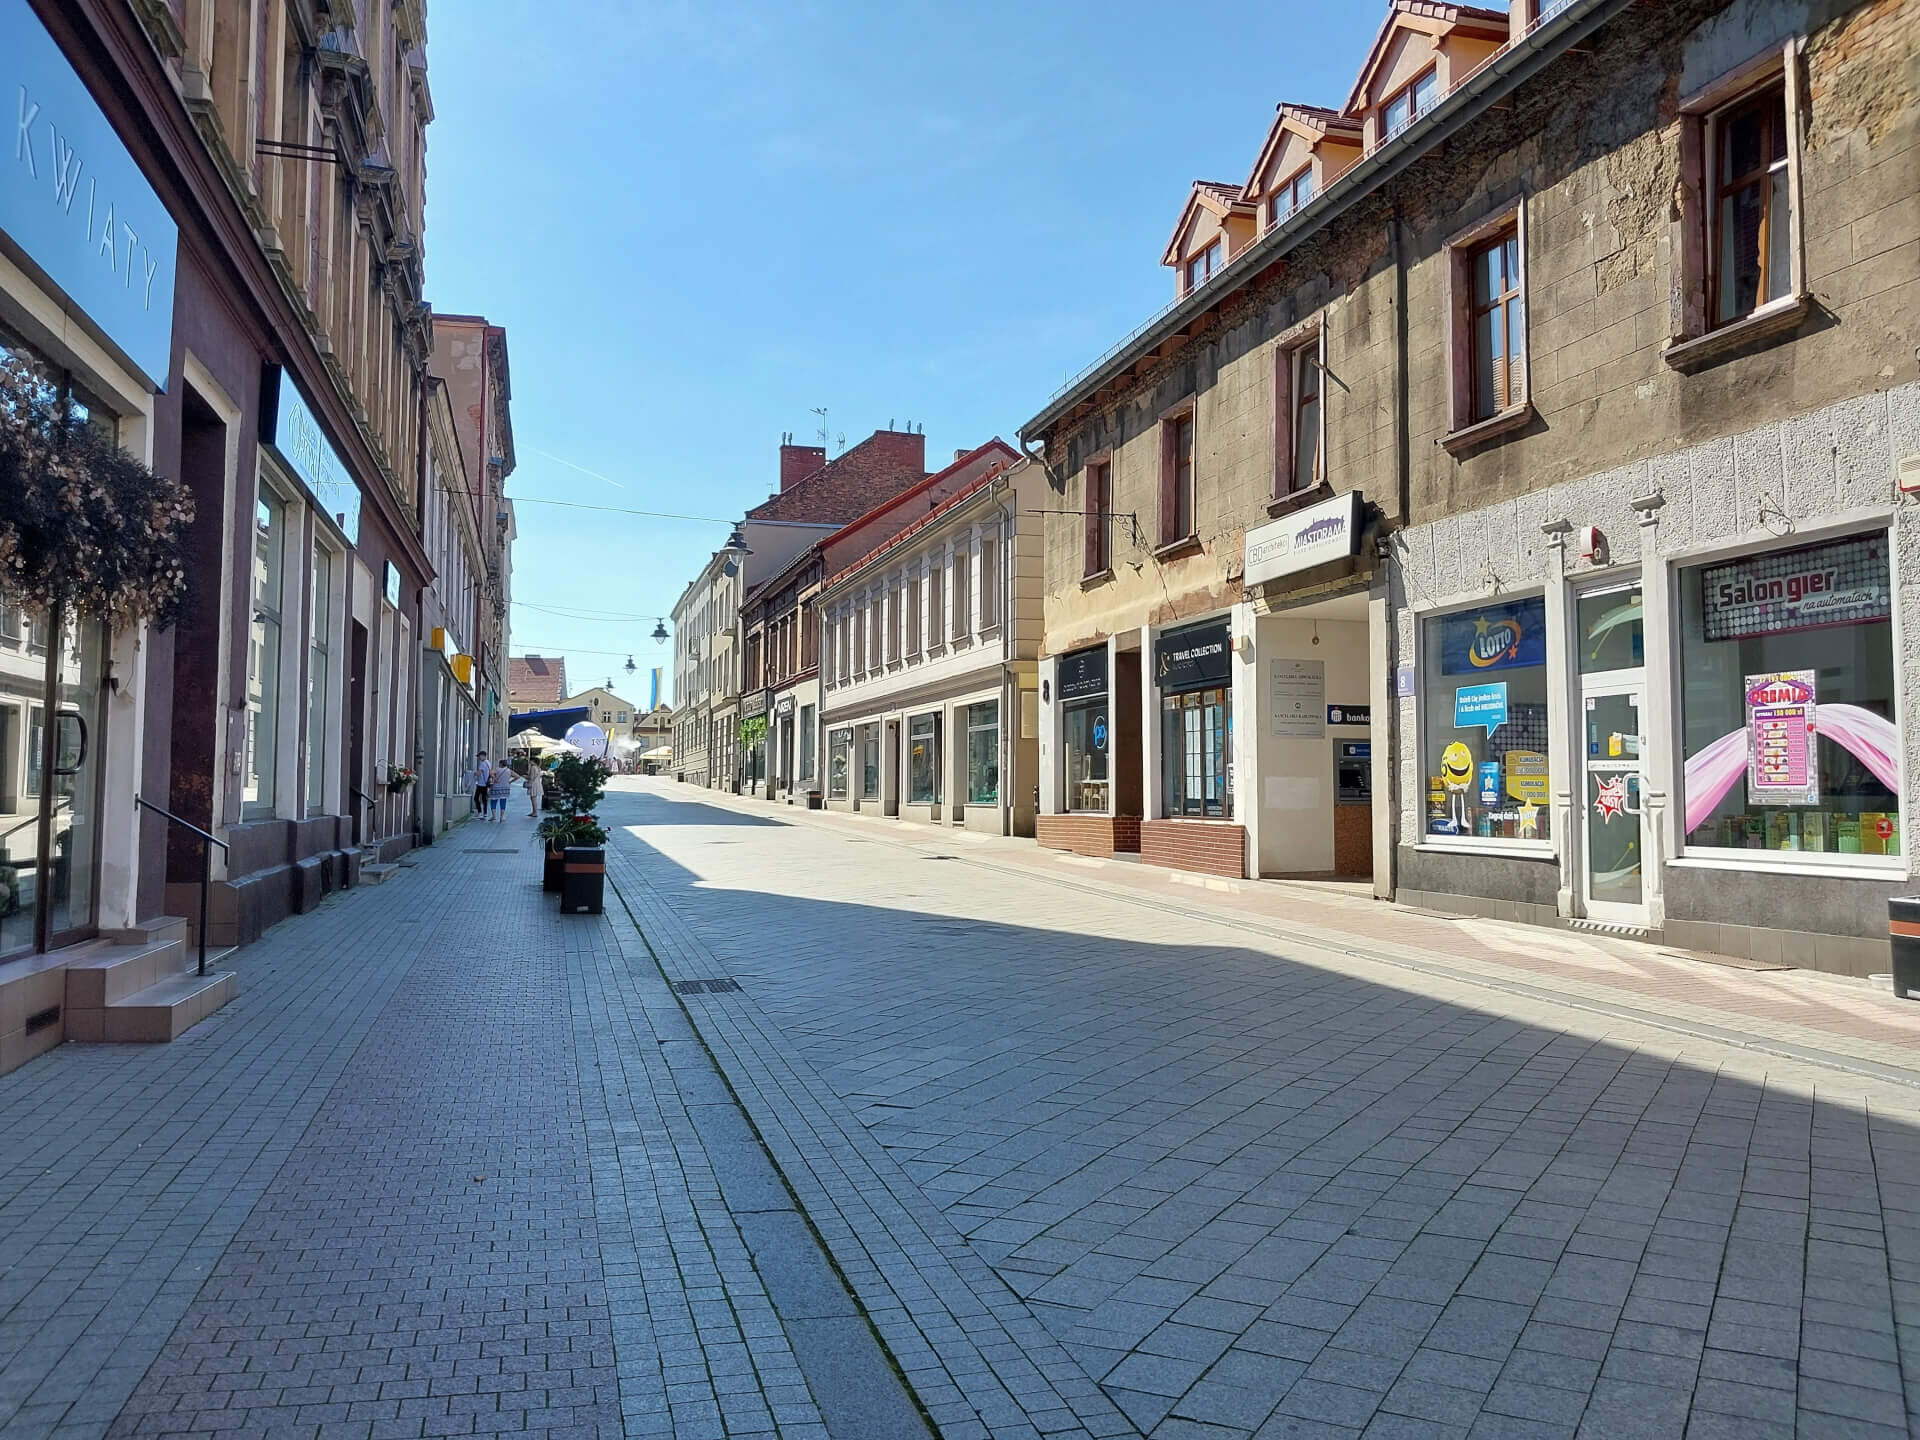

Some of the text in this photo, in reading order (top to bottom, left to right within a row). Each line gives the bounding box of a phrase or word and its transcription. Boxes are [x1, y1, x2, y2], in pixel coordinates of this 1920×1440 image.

[16, 84, 158, 312] KWIATY
[1294, 523, 1347, 550] MIASTORAMA
[1719, 571, 1835, 608] Salon gier
[1803, 588, 1873, 610] na automatach
[1173, 643, 1222, 662] TRAVEL COLLECTION
[1479, 628, 1511, 658] LOTTO
[1400, 675, 1406, 688] 8
